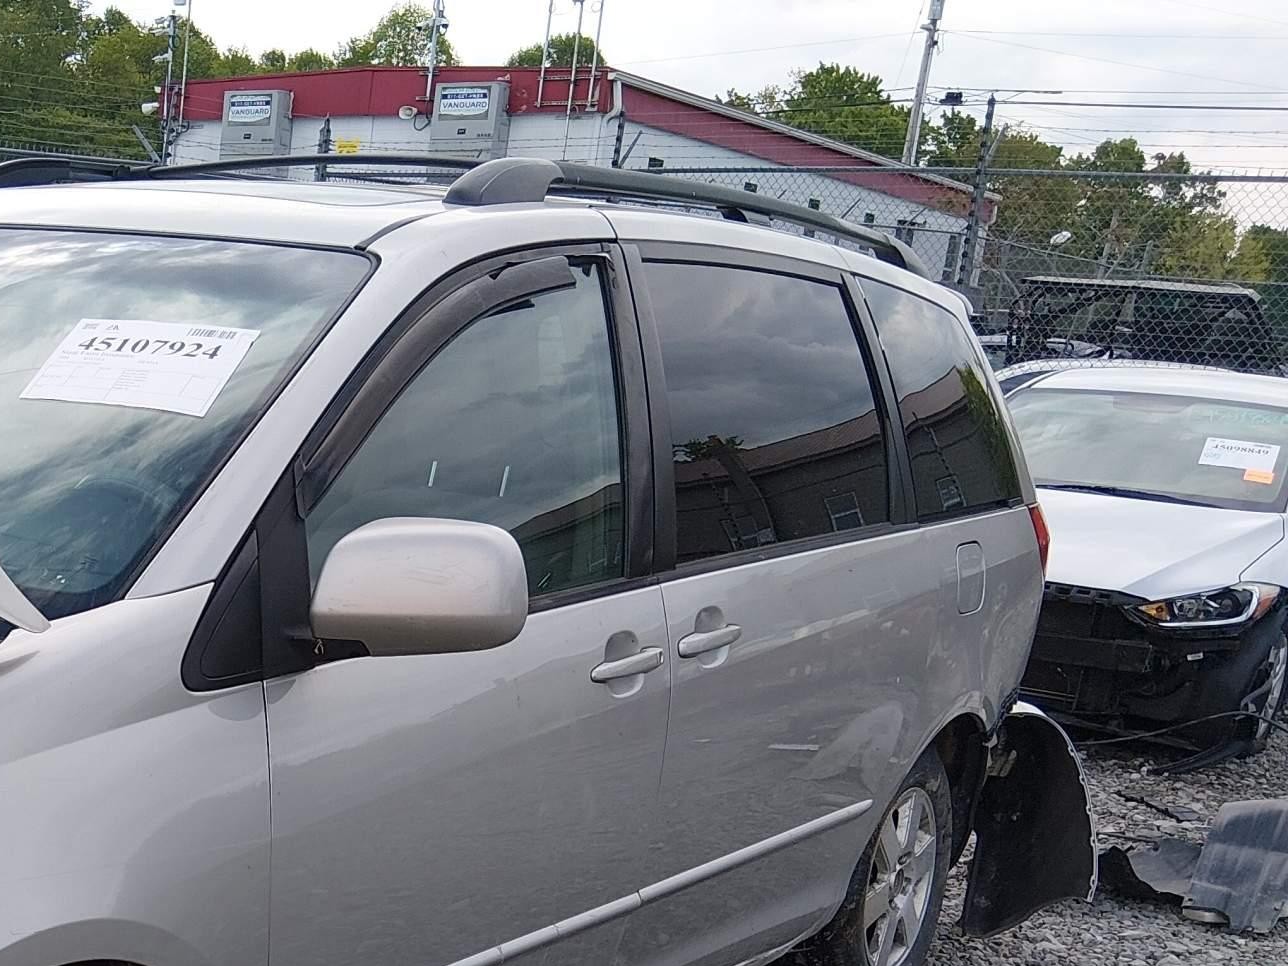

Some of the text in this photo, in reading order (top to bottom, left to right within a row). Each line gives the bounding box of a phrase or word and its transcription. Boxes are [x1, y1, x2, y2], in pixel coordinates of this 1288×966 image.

[442, 101, 488, 109] VANGUARD
[231, 108, 270, 116] VANGUARD
[78, 336, 223, 360] 45107924
